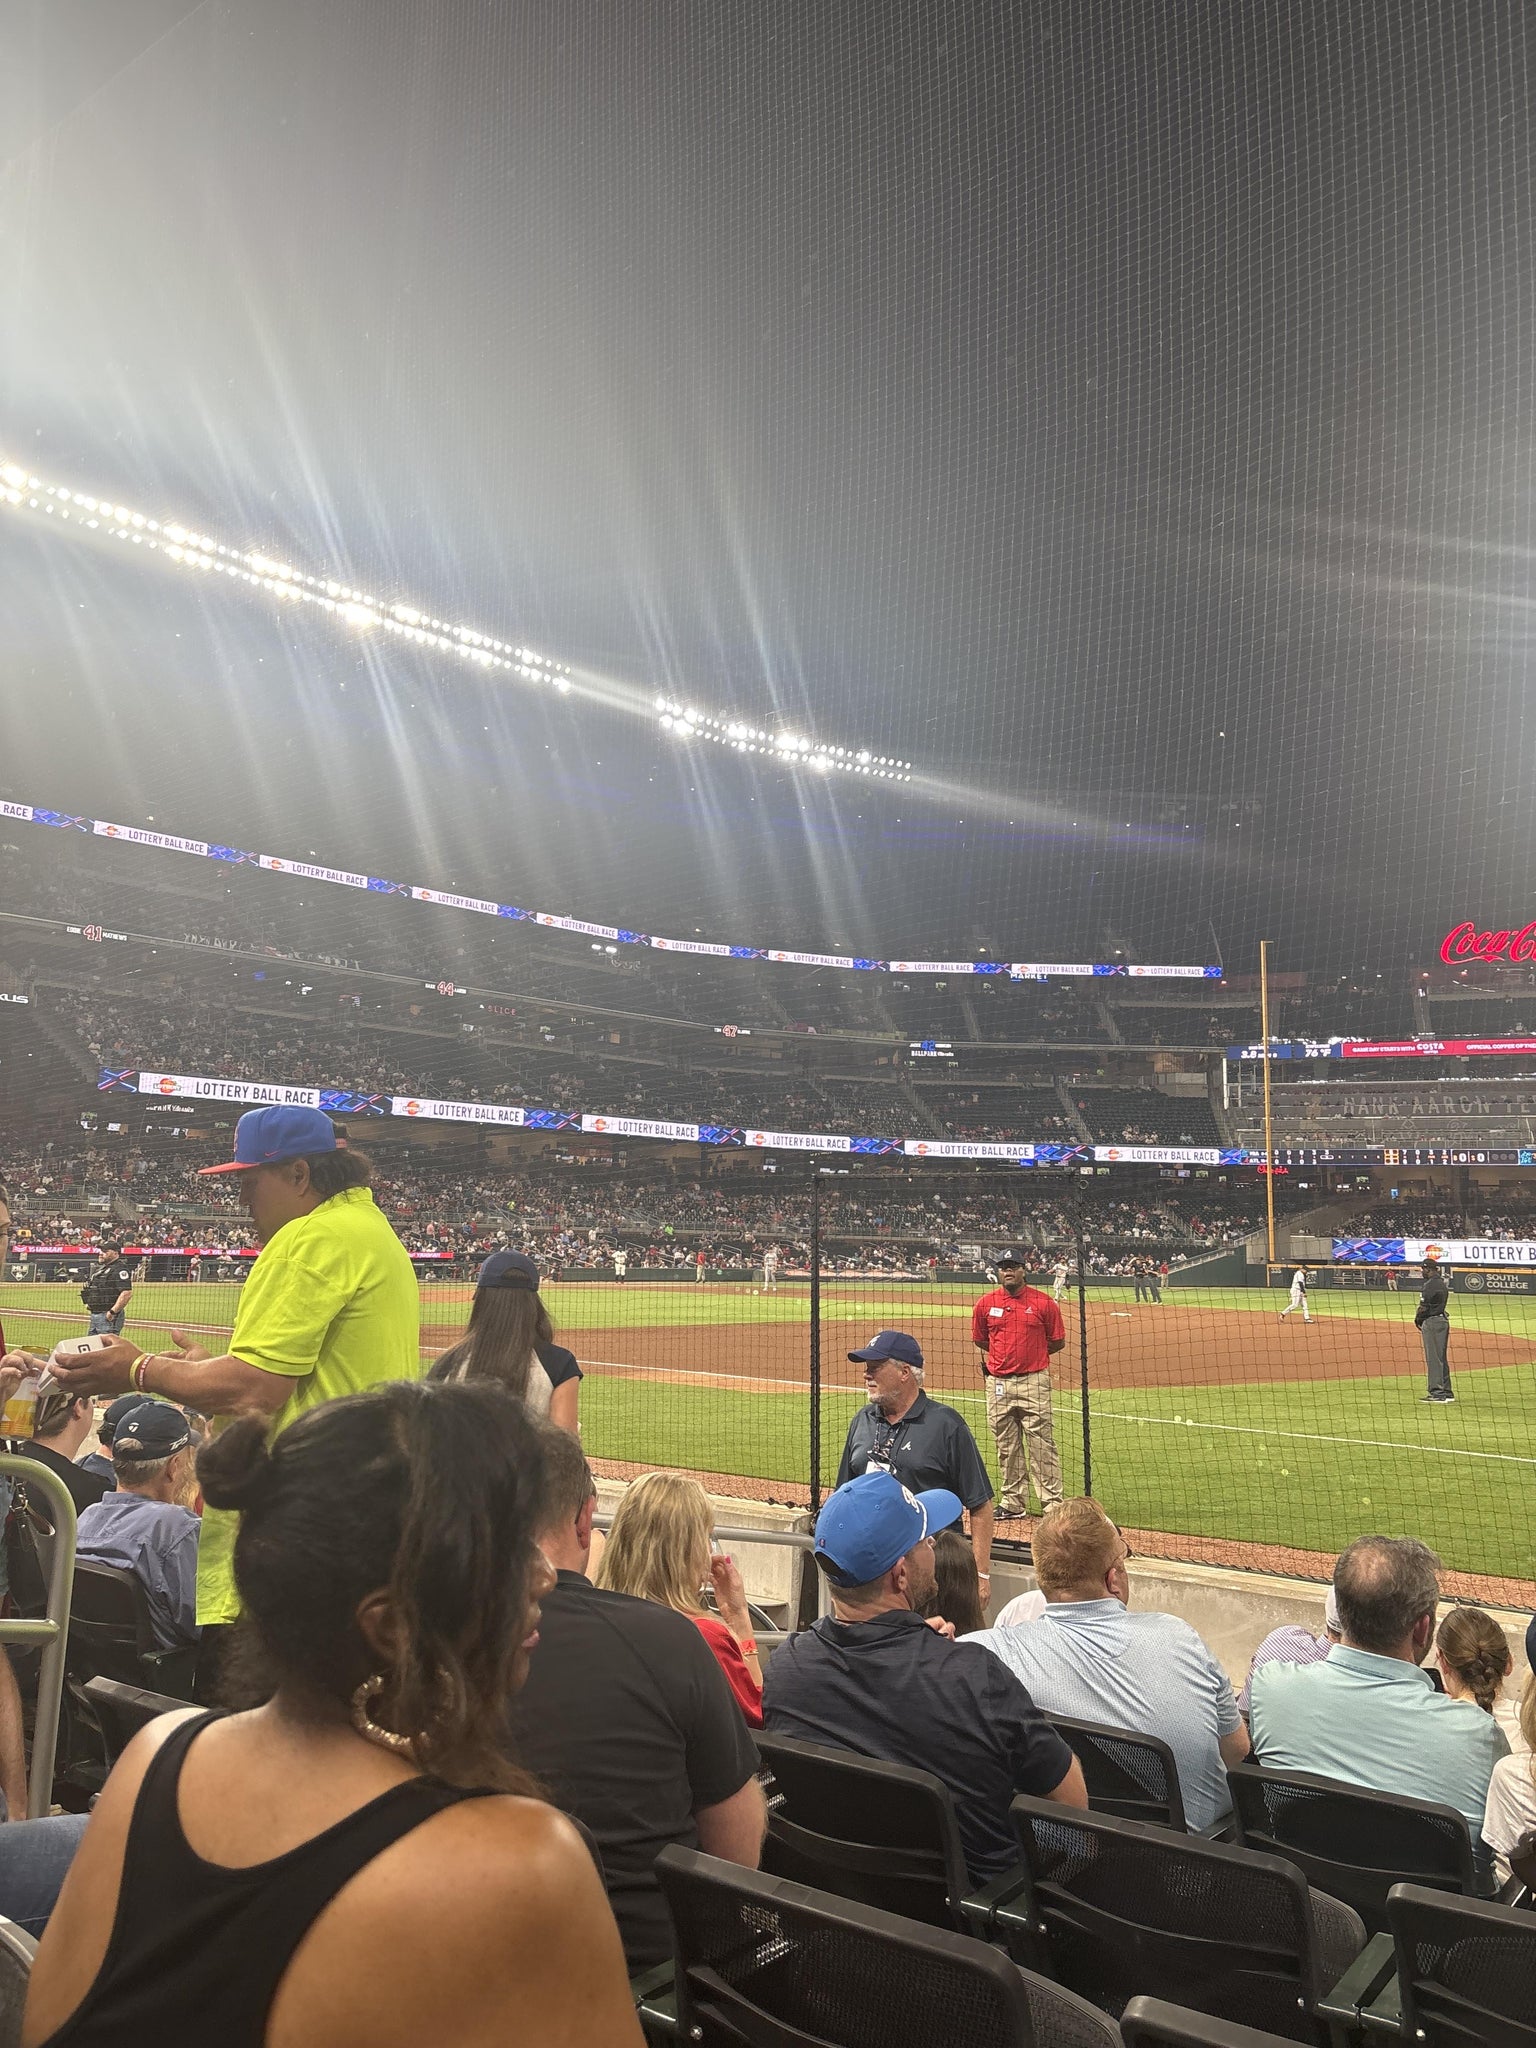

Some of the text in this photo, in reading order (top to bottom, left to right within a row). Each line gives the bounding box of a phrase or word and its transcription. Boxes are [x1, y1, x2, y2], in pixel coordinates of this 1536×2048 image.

[3, 804, 28, 817] RACE
[128, 830, 204, 853] LOTTERY BALL RACE
[292, 863, 364, 886] LOTTERY BALL RACE
[438, 894, 496, 913] LOTTERY BALL RACE
[83, 924, 102, 942] 41
[561, 919, 616, 937] LOTTERY BALL RACE
[672, 941, 727, 954] LOTTERY BALL RACE
[793, 954, 850, 966] LOTTERY BALL RACE
[914, 963, 939, 971] LOTTERY
[955, 964, 970, 972] RACE
[1035, 965, 1060, 973] LOTTERY
[1076, 966, 1090, 974] RACE
[437, 981, 454, 996] 44
[487, 1005, 516, 1015] SLICE
[723, 1025, 738, 1037] 47
[921, 1040, 936, 1051] 42
[1416, 1042, 1445, 1050] COSTA
[195, 1081, 314, 1104] LOTTERY BALL RACE
[1344, 1096, 1399, 1114] HANK
[1412, 1095, 1490, 1114] AARON
[433, 1104, 472, 1118] LOTTERY
[474, 1107, 496, 1120] BALL
[498, 1110, 520, 1122] RACE
[618, 1121, 653, 1134] LOTTERY
[655, 1125, 674, 1136] BALL
[676, 1126, 695, 1137] RACE
[772, 1135, 803, 1147] LOTTERY
[805, 1138, 825, 1148] BALL
[827, 1139, 847, 1149] RACE
[940, 1145, 978, 1155] LOTTERY
[981, 1146, 1004, 1156] BALL
[1006, 1146, 1029, 1156] RACE
[1131, 1149, 1168, 1160] LOTTERY
[1170, 1151, 1191, 1160] BALL
[1193, 1151, 1215, 1161] RACE
[1464, 1246, 1524, 1260] LOTTERY
[1486, 1273, 1519, 1281] SOUTH
[1486, 1281, 1528, 1289] COLLEGE
